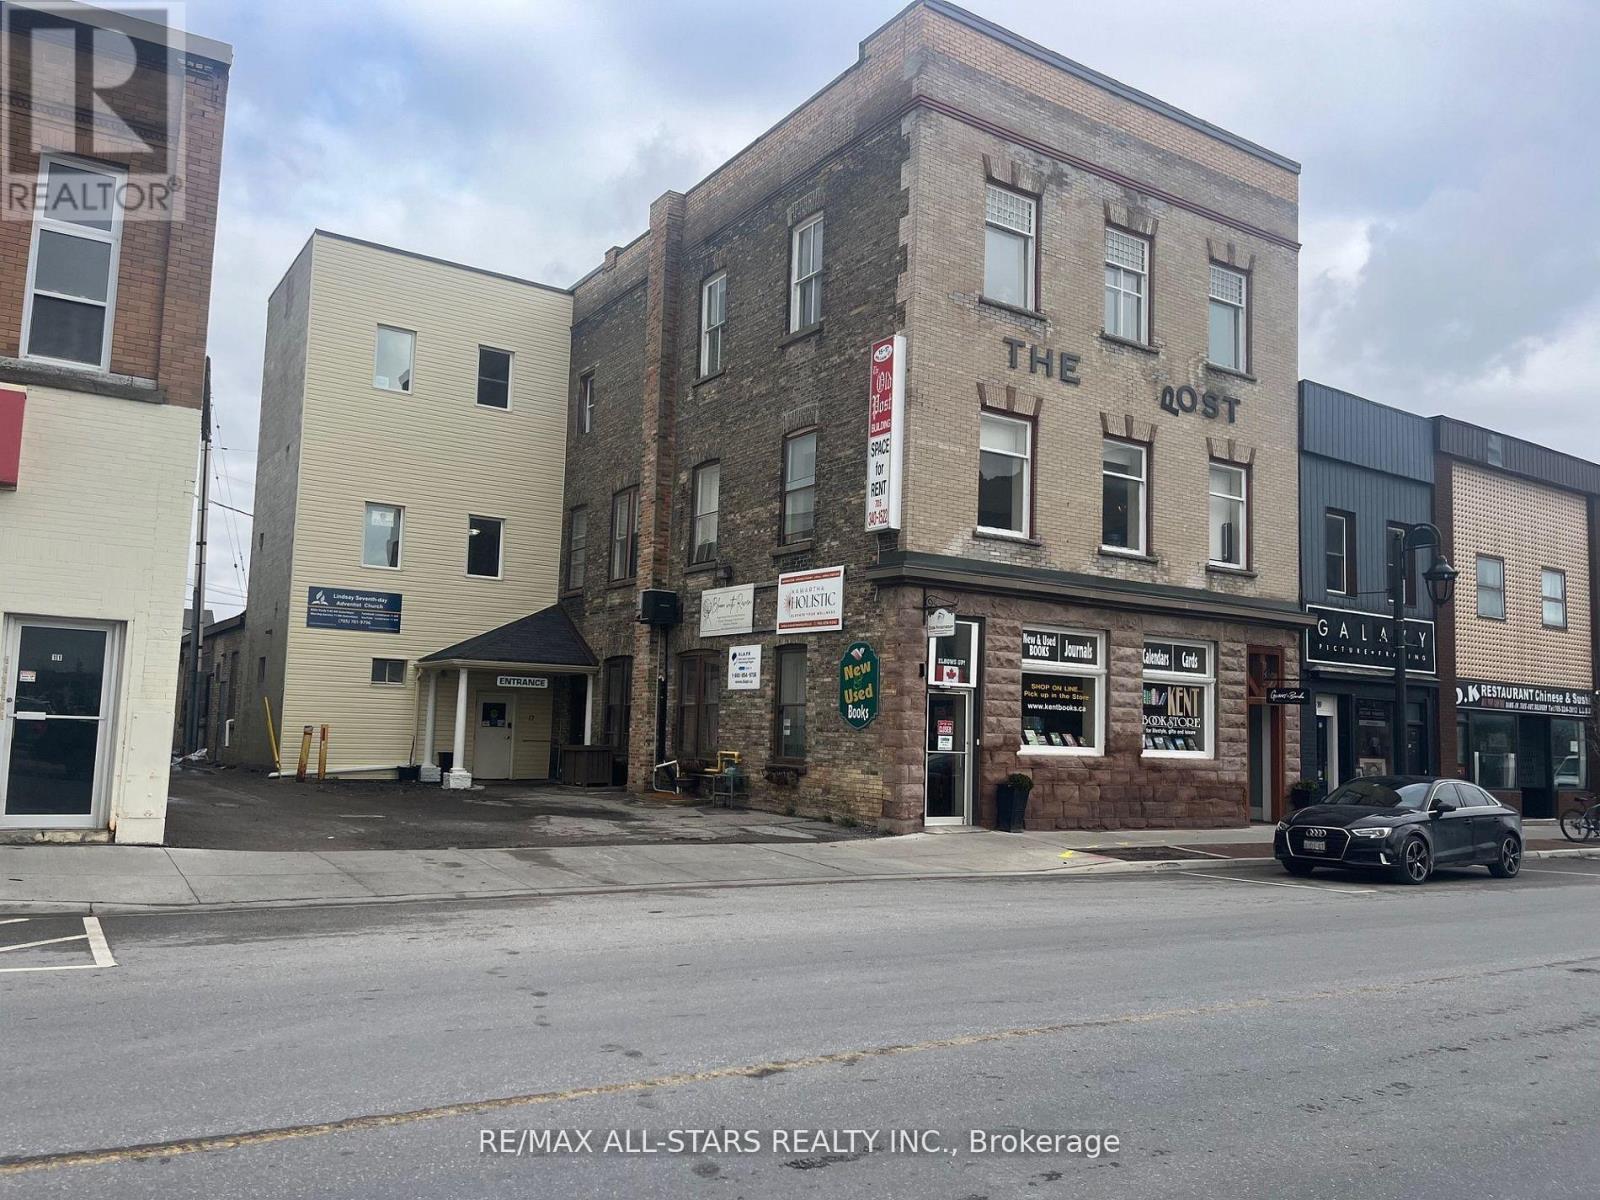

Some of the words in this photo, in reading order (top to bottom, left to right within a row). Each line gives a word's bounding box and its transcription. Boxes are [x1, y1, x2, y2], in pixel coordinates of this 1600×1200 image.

[1002, 336, 1081, 386] THE
[877, 371, 892, 393] Old
[872, 393, 892, 420] Post
[1160, 385, 1241, 424] POST
[871, 419, 891, 433] BUILDING
[871, 438, 890, 458] SPACE
[875, 461, 885, 476] for
[871, 480, 887, 498] RENT
[333, 593, 354, 601] Lindsay
[355, 596, 388, 604] Seventh-day
[789, 591, 836, 610] HOLISTIC
[1022, 633, 1035, 644] New
[1036, 634, 1041, 645] &
[1042, 634, 1057, 647] Used
[1317, 618, 1427, 648] GALAY
[1029, 645, 1050, 657] BOOKS
[1064, 640, 1093, 659] Journals
[1142, 648, 1170, 666] Calendars
[1378, 650, 1427, 661] FRING
[1181, 651, 1198, 669] Cards
[843, 661, 871, 681] New
[500, 677, 546, 687] ENTRANCE
[844, 683, 873, 704] Used
[1167, 686, 1200, 717] KENT
[1481, 684, 1534, 701] RESTAURANT
[1535, 689, 1564, 703] Chinese
[1565, 692, 1571, 703] &
[847, 704, 869, 720] Books
[1027, 703, 1087, 712] www.kentbooks.ca
